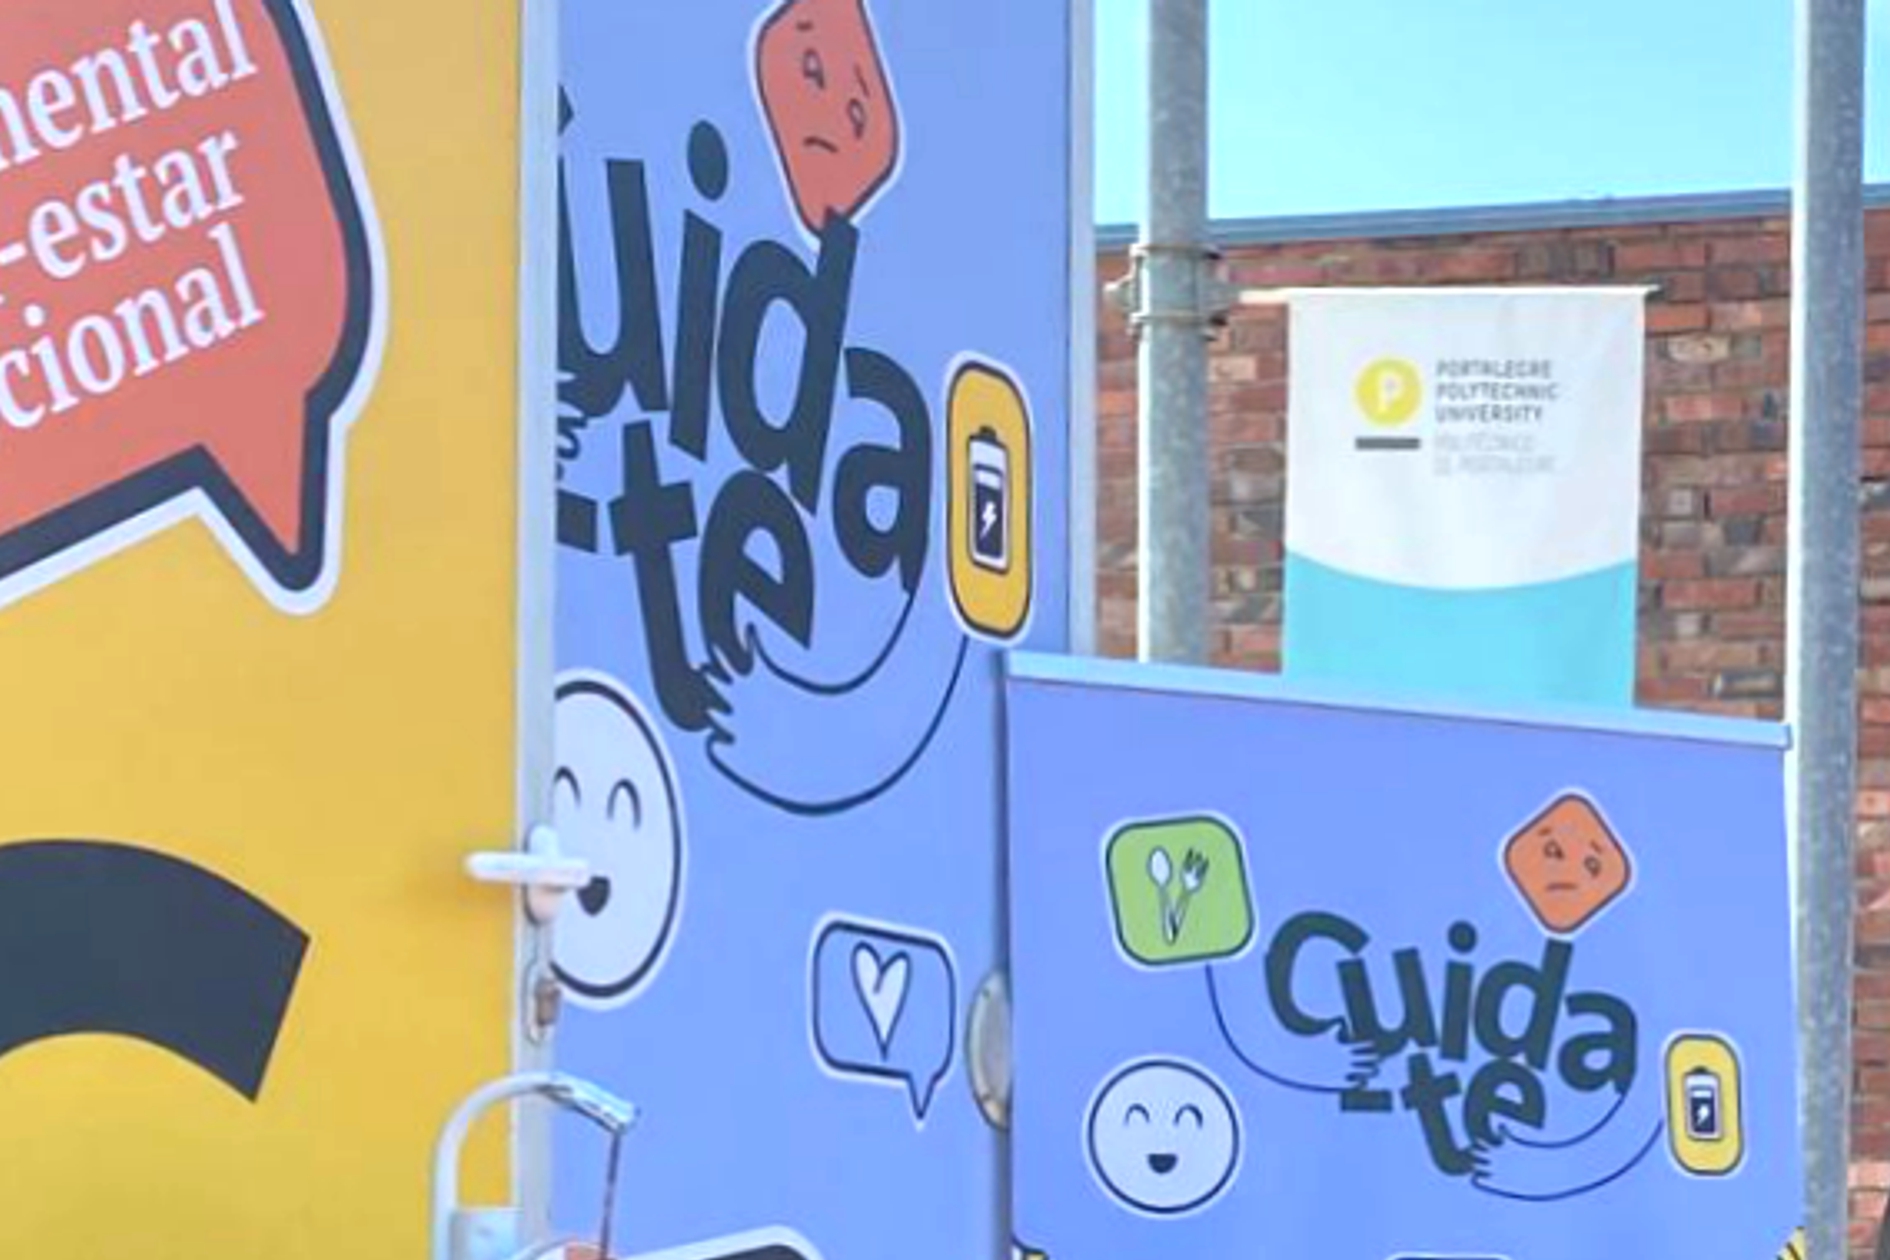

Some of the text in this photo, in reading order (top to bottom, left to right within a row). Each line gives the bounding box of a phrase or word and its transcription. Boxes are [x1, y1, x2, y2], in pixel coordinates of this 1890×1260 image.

[1436, 360, 1552, 379] PORTALEGRE
[1435, 383, 1560, 401] POLYTECHNIC
[1435, 405, 1543, 422] UNIVERSITY
[1264, 911, 1638, 1096] Cuida
